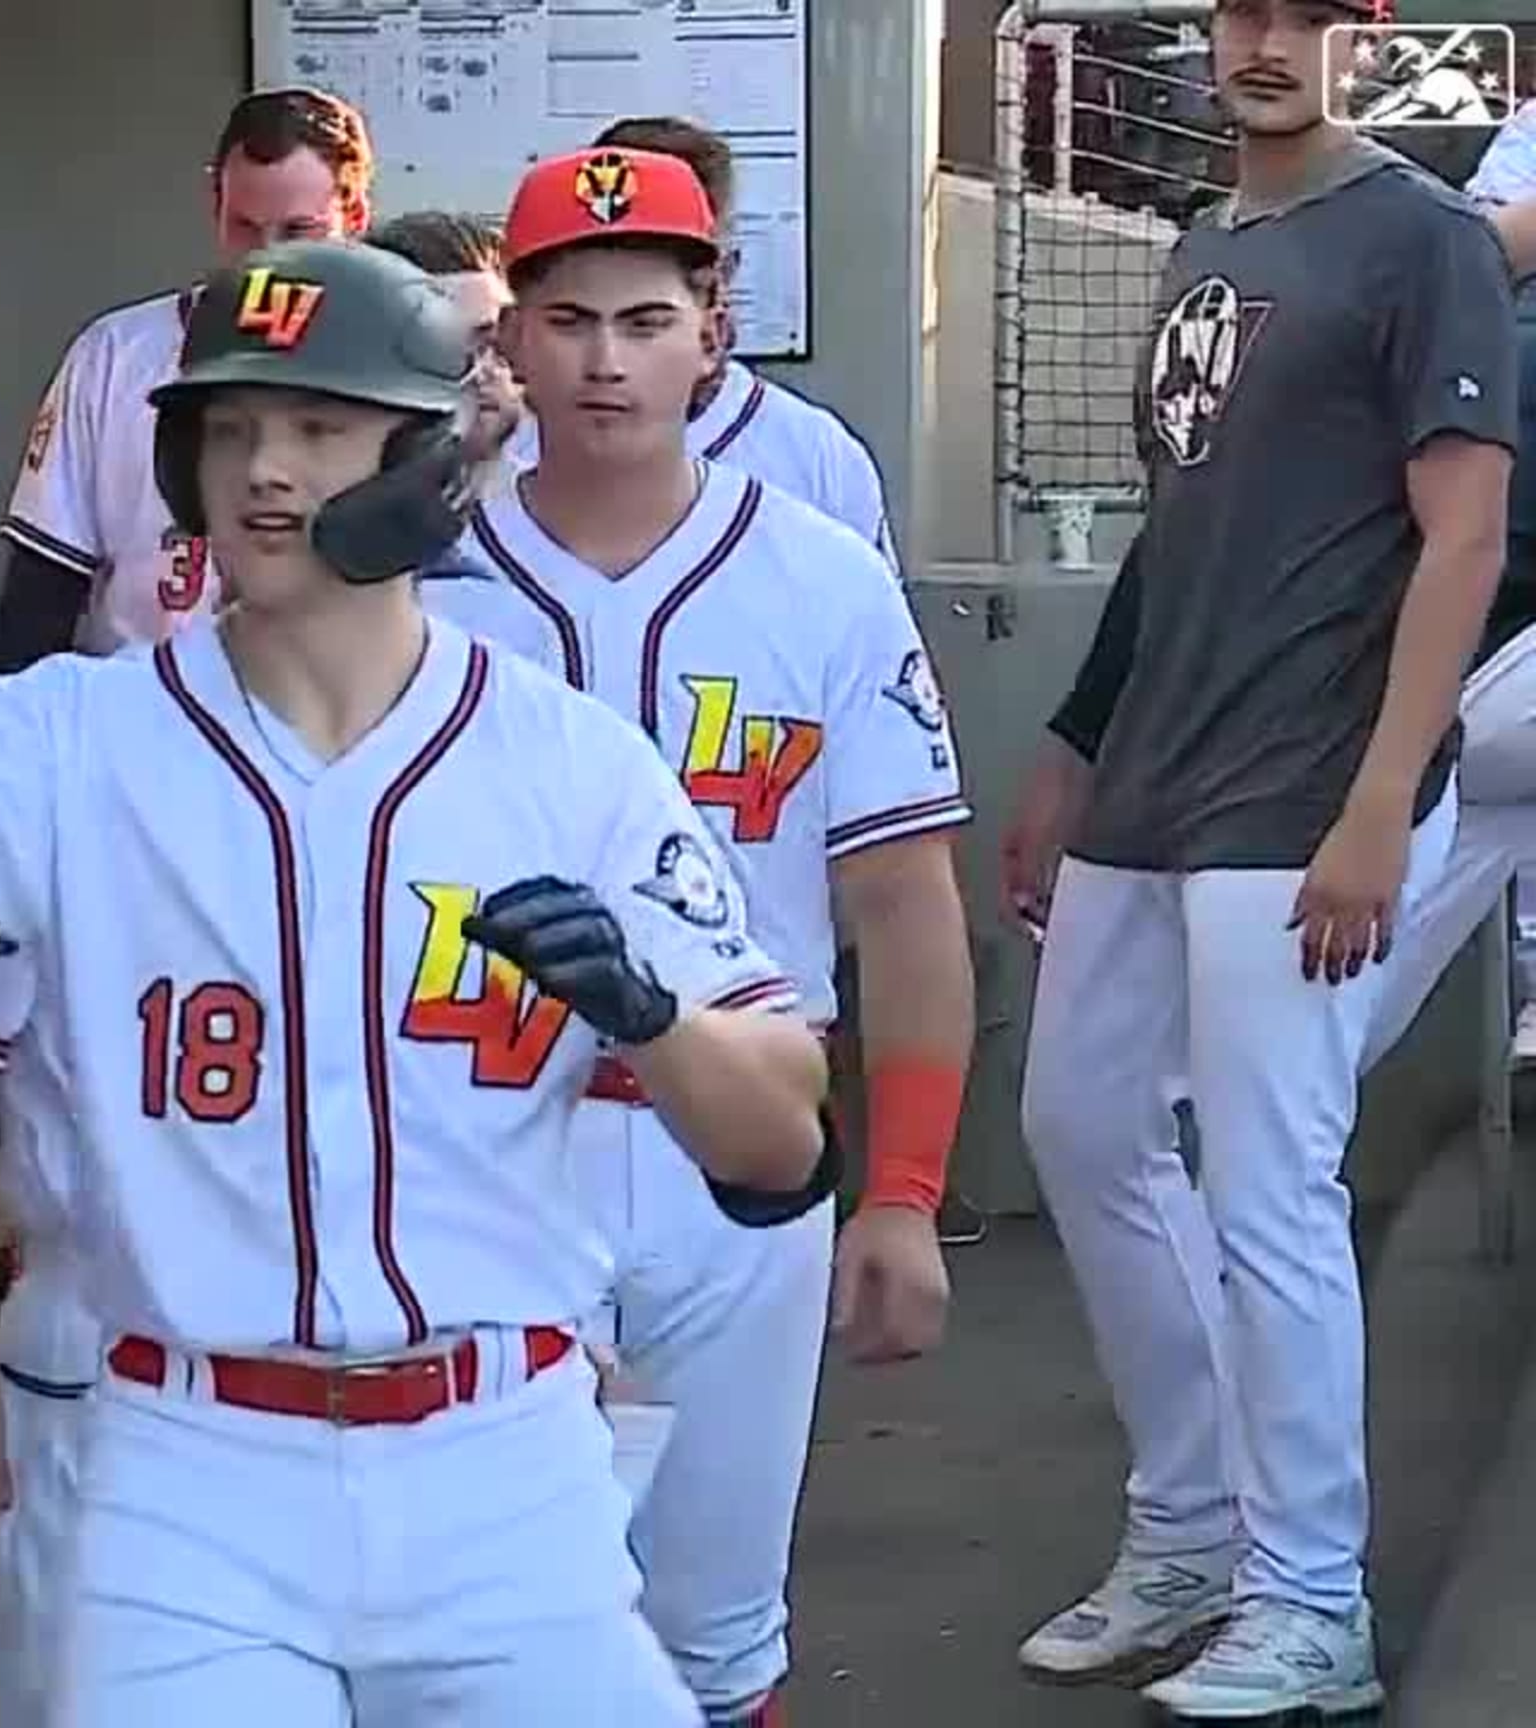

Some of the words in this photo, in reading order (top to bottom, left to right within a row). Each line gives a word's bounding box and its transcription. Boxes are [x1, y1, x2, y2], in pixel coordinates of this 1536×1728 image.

[237, 266, 325, 347] LV
[678, 673, 823, 844] LV
[137, 976, 265, 1124] 18
[399, 880, 576, 1088] LV
